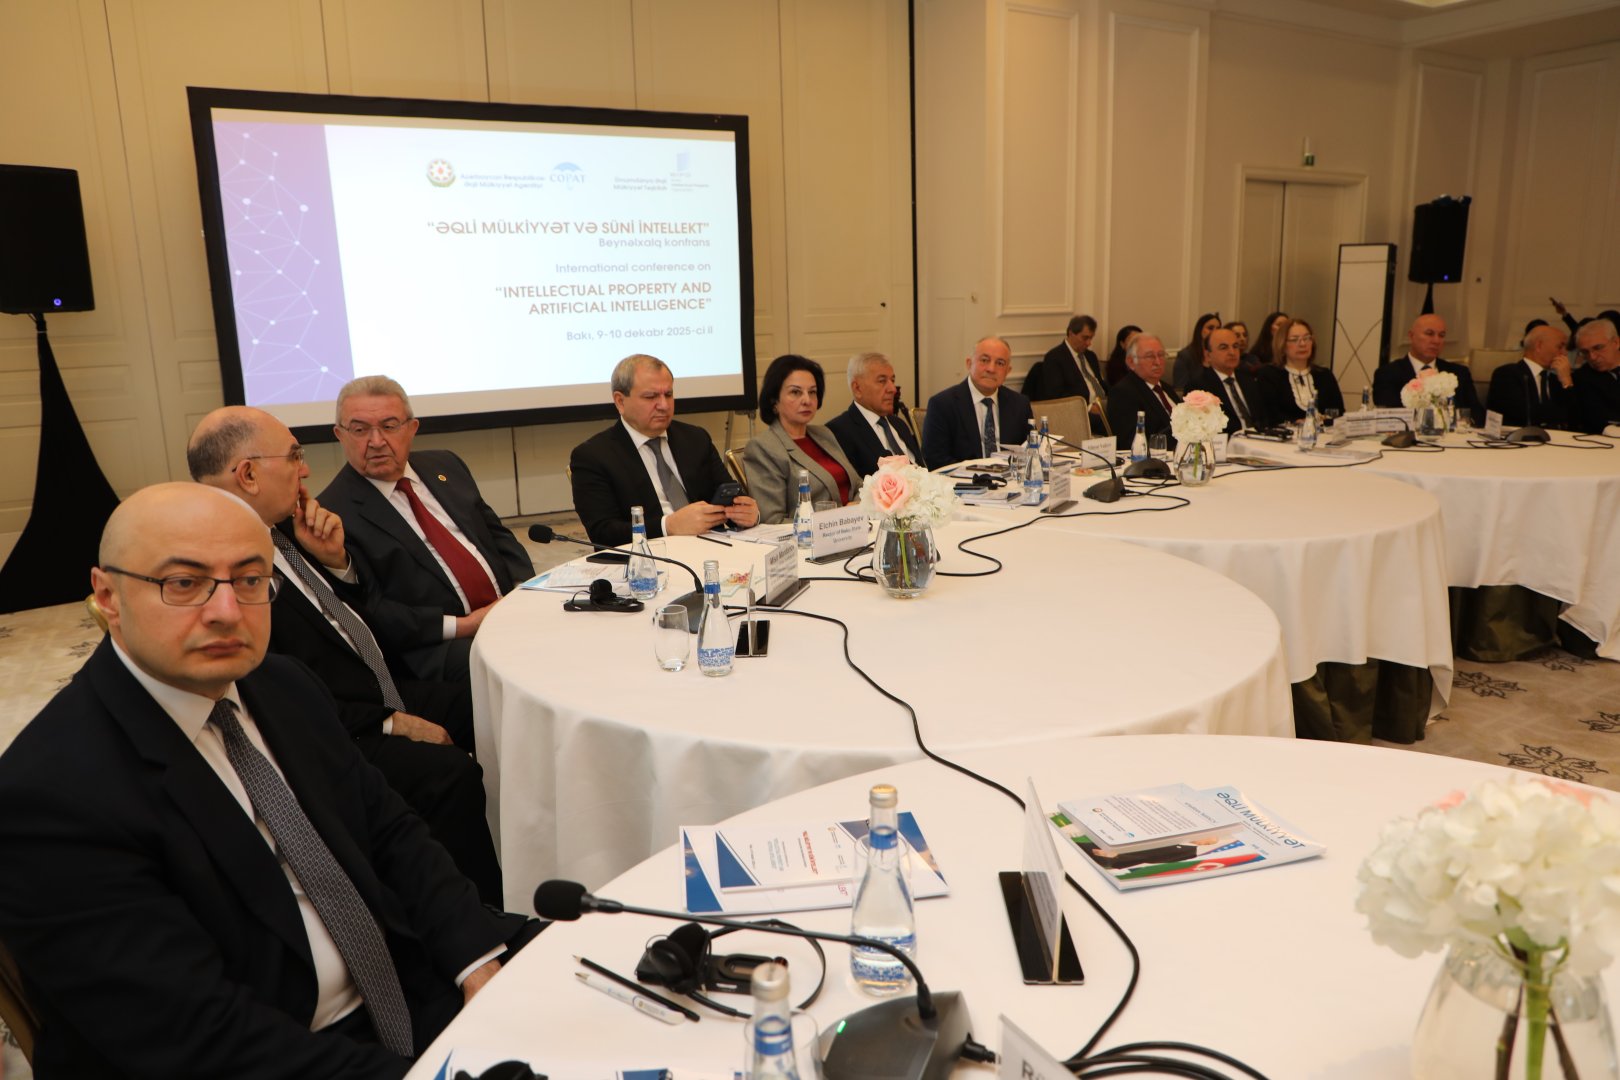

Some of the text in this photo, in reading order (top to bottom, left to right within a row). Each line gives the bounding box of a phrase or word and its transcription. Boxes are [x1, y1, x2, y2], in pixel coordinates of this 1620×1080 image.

[549, 173, 587, 184] COPAT
[481, 220, 571, 235] MÜLKİYYƏT
[574, 221, 598, 234] VƏ
[601, 219, 635, 234] SÜNİ
[598, 236, 711, 249] Beynəlxalq konfrans
[555, 261, 711, 273] International conference on
[607, 282, 678, 296] PROPERTY
[680, 281, 712, 294] AND
[528, 301, 608, 315] ARTIFICIAL
[596, 328, 622, 341] 9-10
[624, 327, 664, 339] dekabr
[666, 326, 705, 338] 2025-ci
[819, 516, 864, 530] Elchin Babayev
